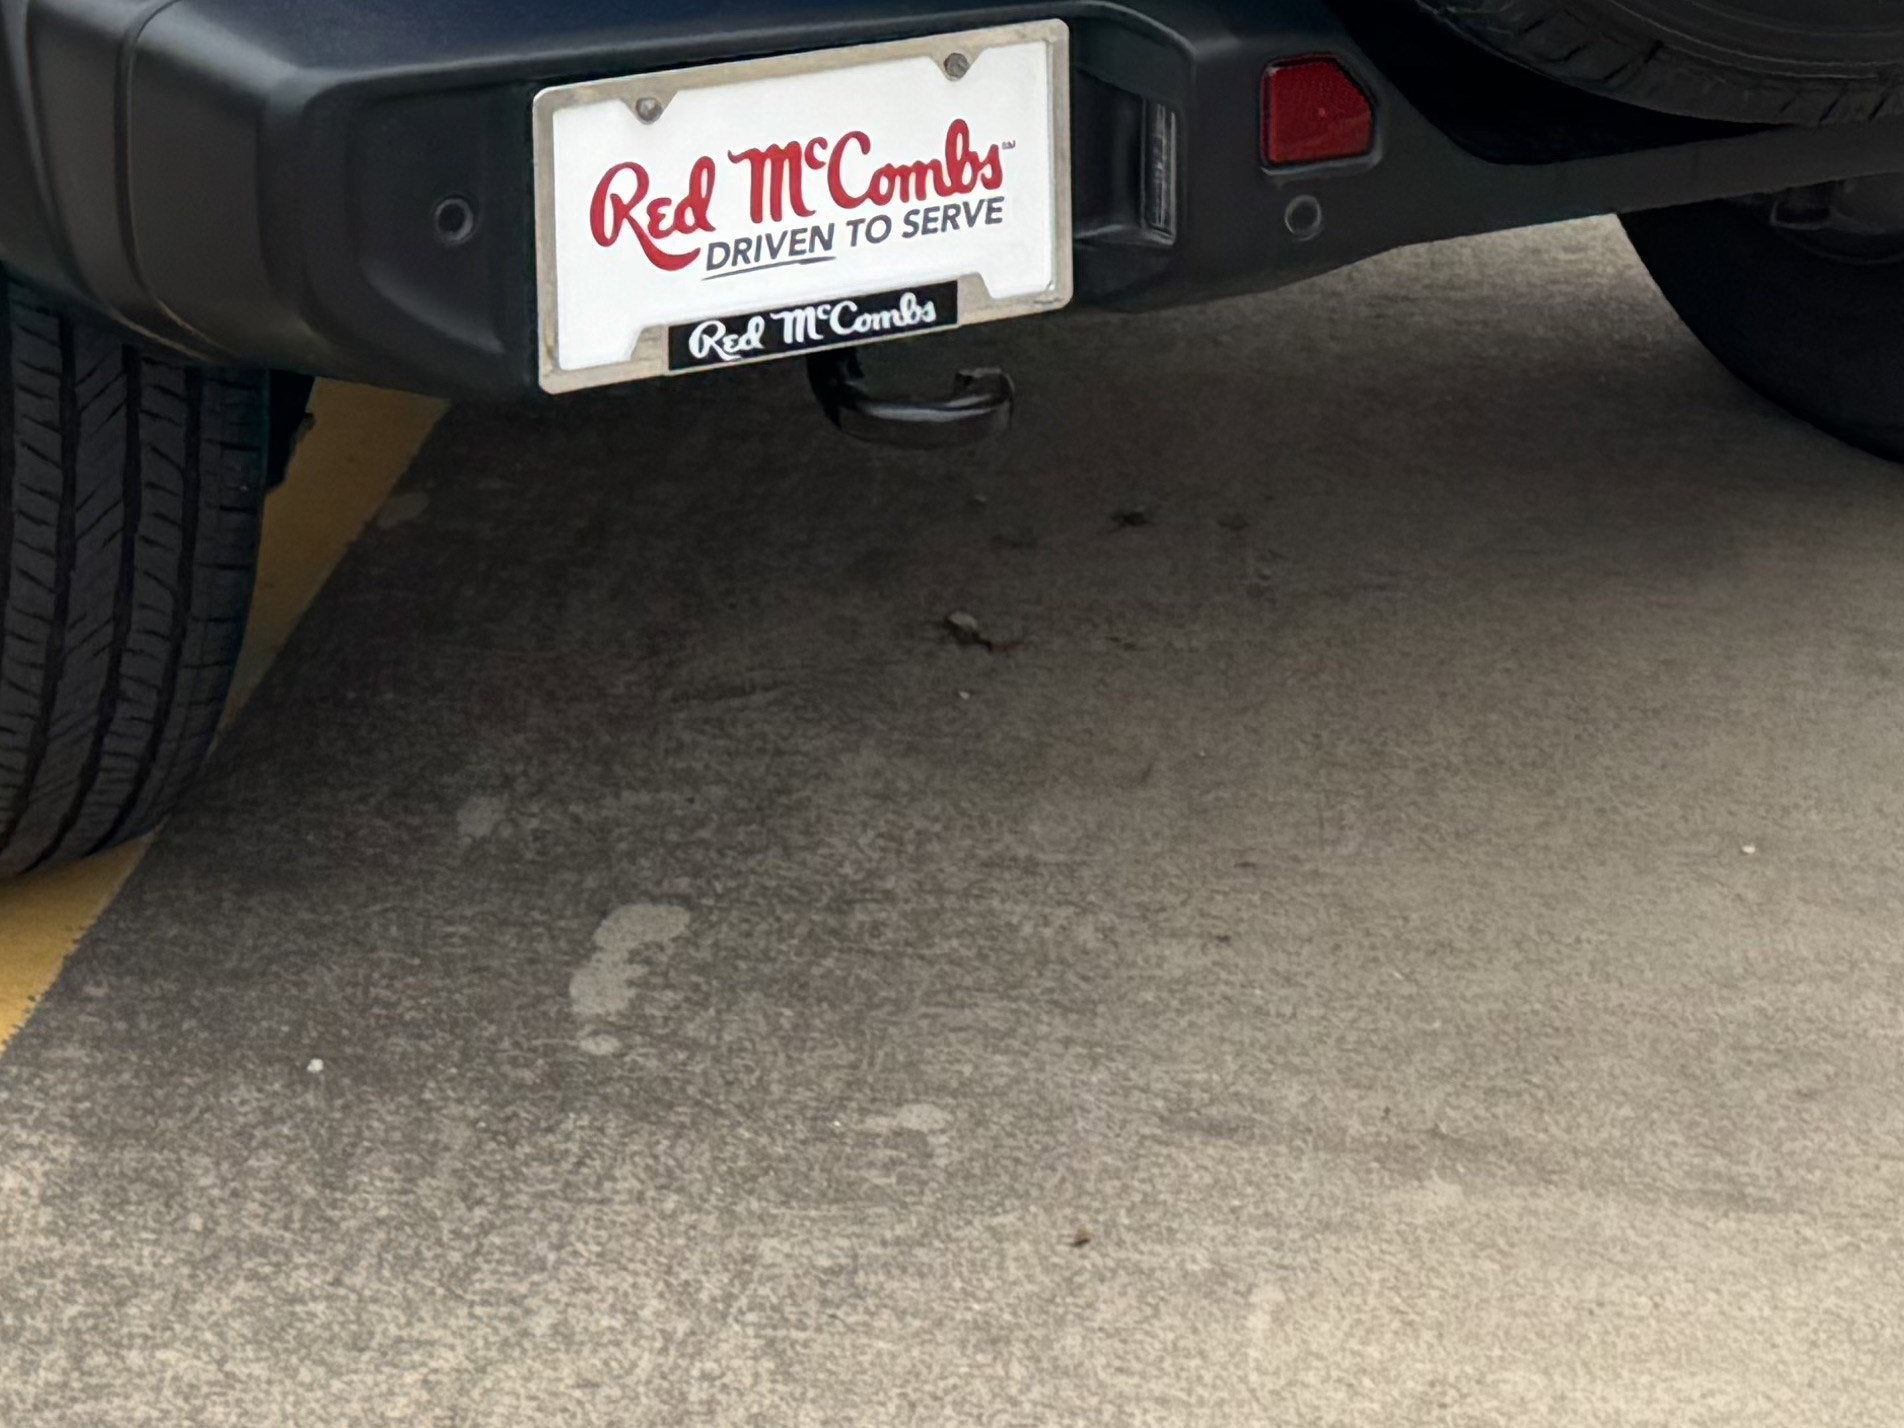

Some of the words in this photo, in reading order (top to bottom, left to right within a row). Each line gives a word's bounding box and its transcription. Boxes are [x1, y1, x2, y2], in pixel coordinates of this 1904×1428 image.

[590, 155, 717, 271] Red
[728, 118, 1004, 224] McCombs
[705, 222, 836, 272] DRIVEN
[847, 214, 893, 247] TO
[902, 195, 1006, 239] SERVE
[688, 316, 766, 361] Red
[770, 292, 937, 344] McCombs
